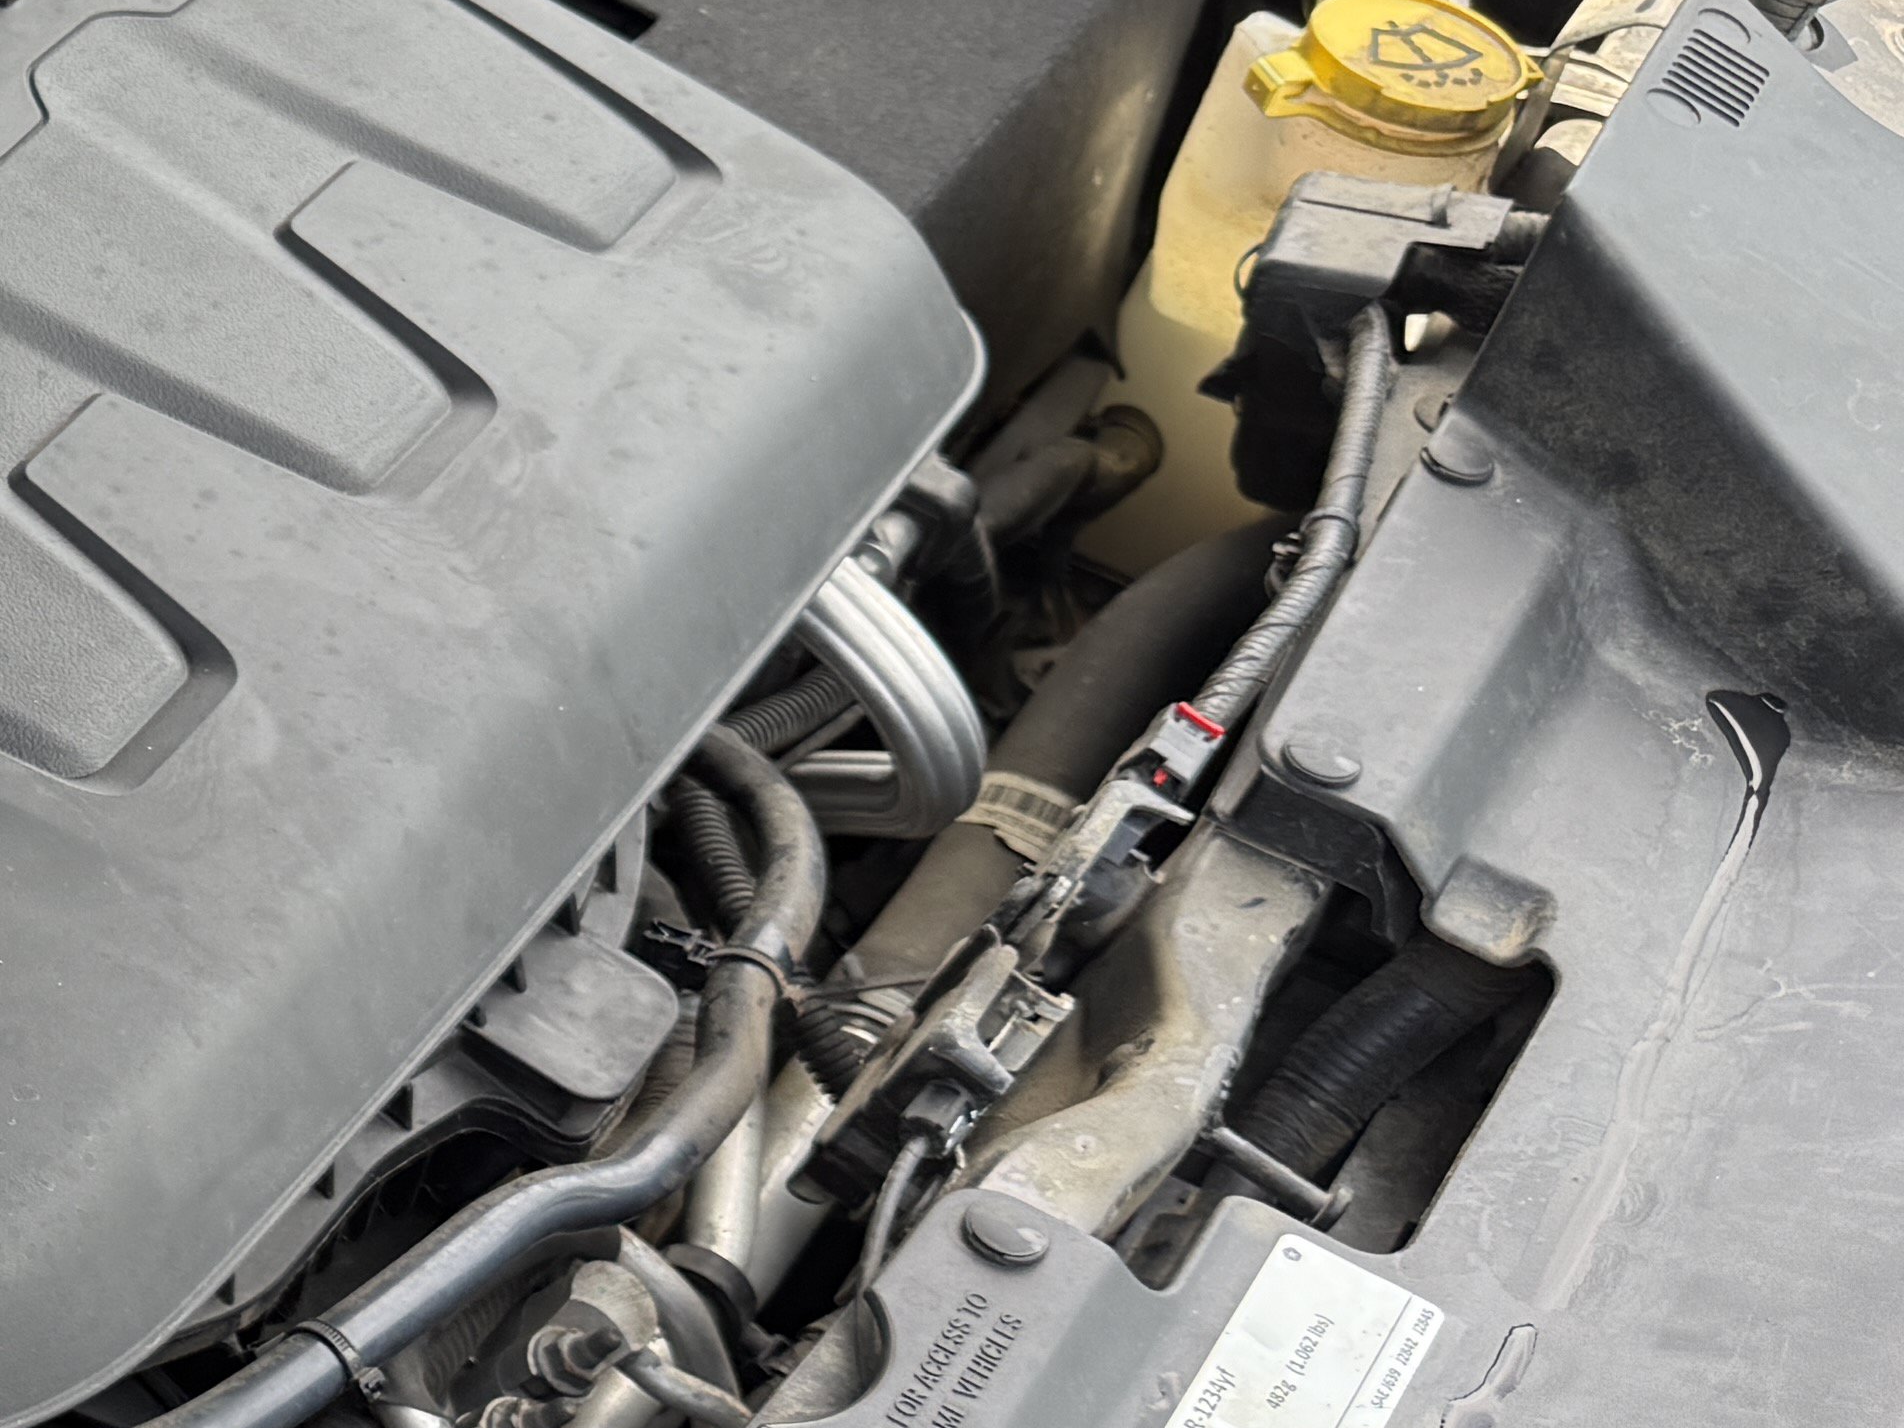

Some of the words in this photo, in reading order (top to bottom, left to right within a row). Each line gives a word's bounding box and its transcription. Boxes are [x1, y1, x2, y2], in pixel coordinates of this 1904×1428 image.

[1266, 1380, 1297, 1411] 482g
[1286, 1334, 1320, 1377] (1.062
[1307, 1313, 1335, 1339] lbs)
